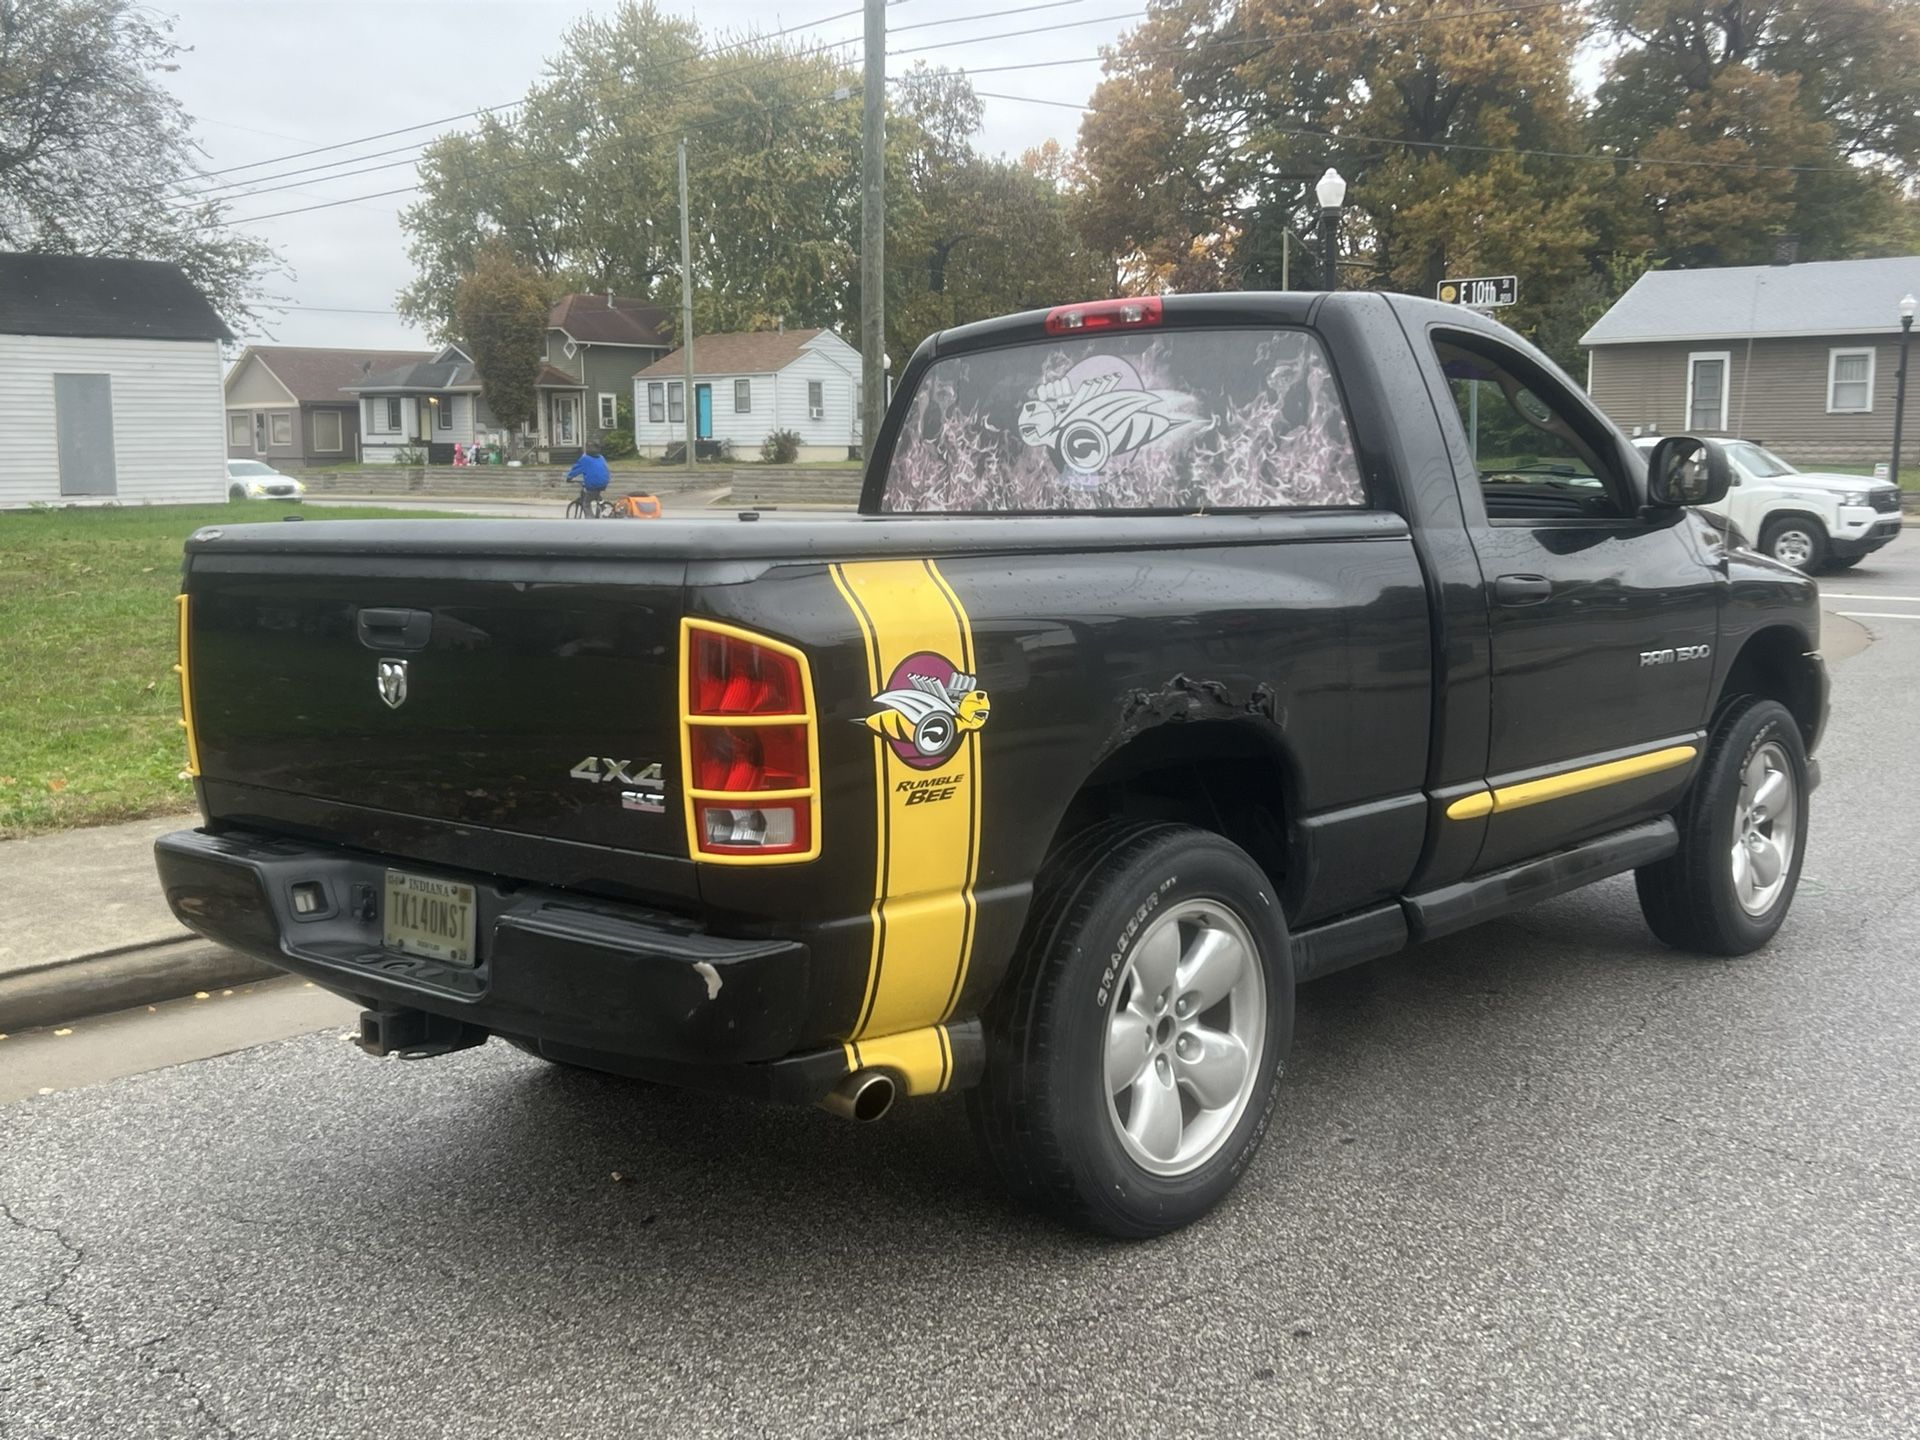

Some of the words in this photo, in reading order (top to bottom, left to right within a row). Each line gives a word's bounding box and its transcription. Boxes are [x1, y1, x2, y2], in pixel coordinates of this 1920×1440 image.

[1460, 282, 1468, 304] E
[1472, 281, 1496, 304] 10th
[1639, 649, 1675, 668] RAM
[1675, 644, 1711, 662] 1500
[895, 773, 965, 793] RUMBLE
[904, 786, 957, 806] BEE
[408, 878, 450, 897] INDIANA
